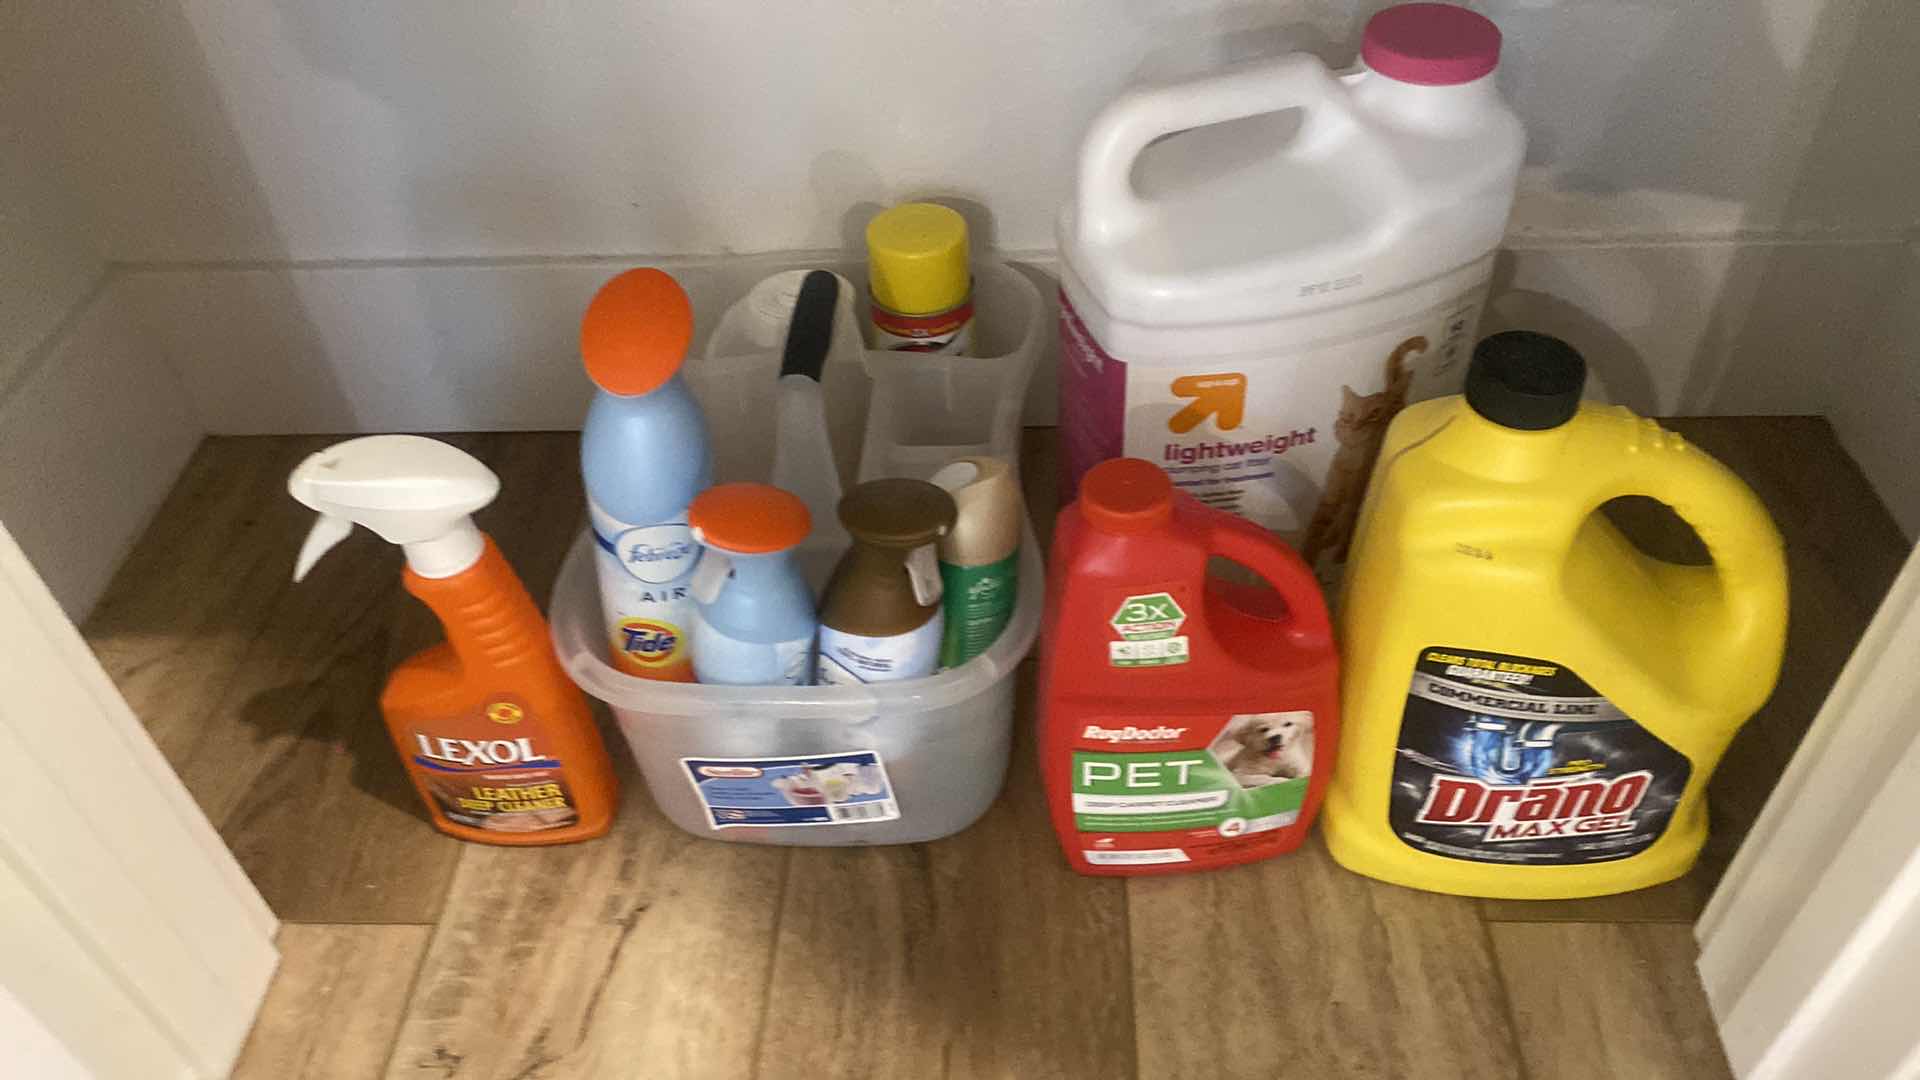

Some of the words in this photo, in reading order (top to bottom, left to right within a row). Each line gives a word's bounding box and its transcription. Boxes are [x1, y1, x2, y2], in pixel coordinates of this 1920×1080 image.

[1164, 428, 1316, 463] lightweight
[639, 587, 688, 603] AIR
[622, 627, 679, 653] Tide
[1428, 682, 1550, 713] COMMERCIAL
[415, 732, 547, 766] LEXOL
[1082, 760, 1204, 787] PET
[472, 783, 564, 801] LEATHER
[1491, 821, 1568, 839] MAX
[1574, 815, 1636, 833] GEL
